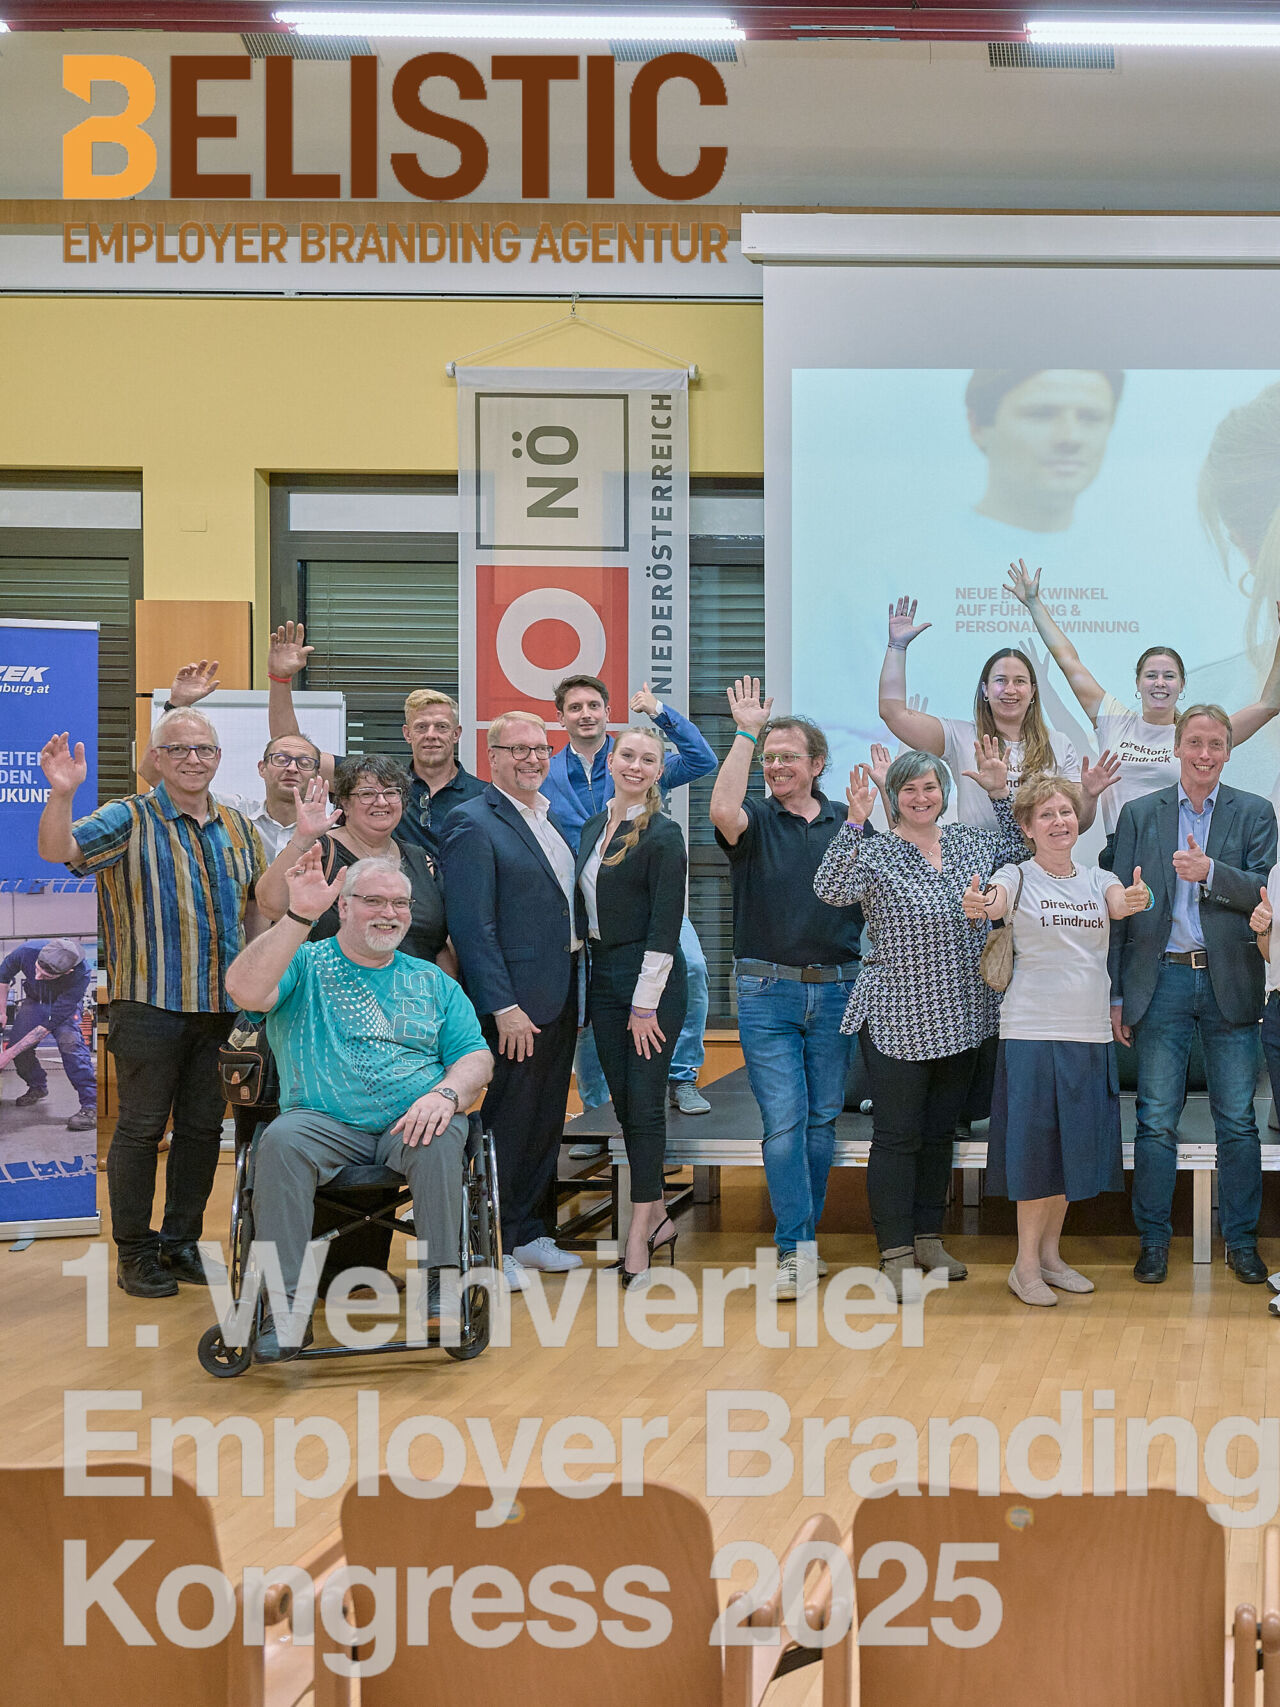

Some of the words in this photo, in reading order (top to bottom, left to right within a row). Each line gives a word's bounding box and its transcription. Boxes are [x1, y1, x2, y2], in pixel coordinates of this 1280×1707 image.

[645, 393, 673, 695] NIEDERÖSTERREICH
[955, 587, 998, 600] NEUE
[1001, 587, 1109, 600] BKWINKEL
[955, 604, 987, 616] AUF
[990, 601, 1067, 616] FÜHRNG
[955, 620, 1140, 633] PERSONALWINNUNG
[1040, 899, 1099, 911] Direktorin
[1040, 916, 1050, 928] 1.
[1052, 914, 1104, 928] Eindruck
